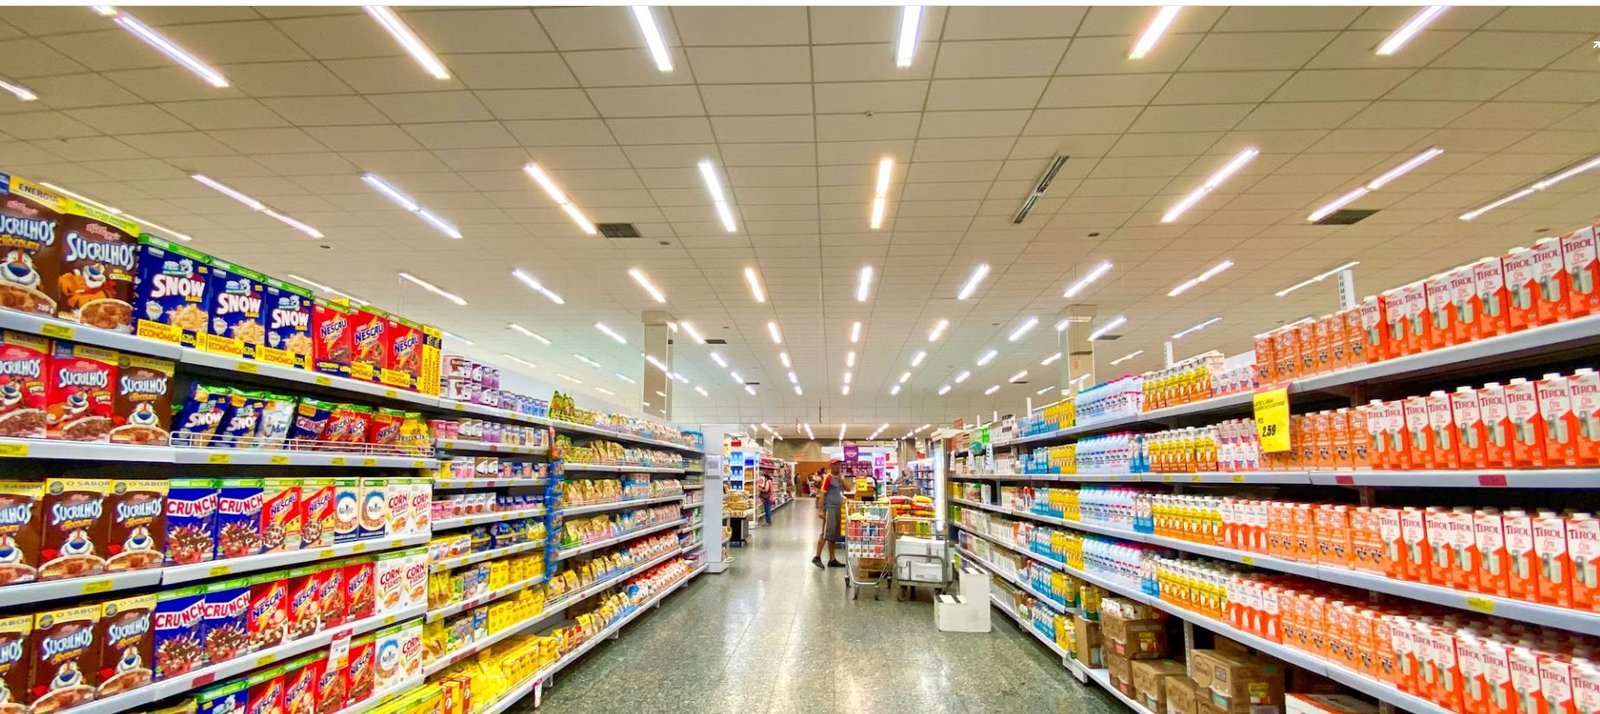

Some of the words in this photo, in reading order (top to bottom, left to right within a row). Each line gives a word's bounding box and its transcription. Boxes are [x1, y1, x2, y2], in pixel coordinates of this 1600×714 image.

[66, 232, 136, 270] SUCRILHOS
[1563, 239, 1594, 253] TIROL
[1505, 259, 1532, 272] TIROL
[1532, 249, 1561, 263] TIROL
[1476, 268, 1500, 280] TIROL
[151, 273, 206, 298] SNOW
[217, 292, 261, 315] SNOW
[271, 308, 309, 329] SNOW
[320, 318, 348, 337] NESCAU
[354, 321, 384, 344] NESCAU
[394, 335, 419, 354] NESCAU
[58, 368, 109, 389] SUCRILHOS
[121, 375, 168, 395] SUCRILHOS
[1506, 393, 1535, 403] TIROL
[1539, 389, 1568, 399] TIROL
[1570, 384, 1600, 396] TIROL
[1454, 400, 1477, 409] TIROL
[1481, 396, 1504, 407] TIROL
[167, 496, 217, 515] CRUNCH
[220, 494, 263, 513] CRUNCH
[271, 492, 297, 516] NESCAU
[308, 490, 332, 512] NESCAU
[388, 493, 408, 509] CORN
[412, 493, 429, 507] CORN
[52, 499, 103, 526] SUCRILHOS
[117, 497, 162, 523] SUCRILHOS
[1475, 524, 1500, 534] TIROL
[1505, 525, 1531, 536] TIROL
[1534, 527, 1565, 539] TIROL
[1568, 529, 1599, 541] TIROL
[380, 568, 401, 585] CORN
[406, 562, 424, 578] CORN
[348, 568, 371, 593] NESCAU
[205, 593, 250, 617] CRUNCH
[252, 586, 285, 620] NESCAU
[292, 580, 318, 611] NESCAU
[155, 602, 205, 628] CRUNCH
[109, 613, 150, 646] SUCRILHOS
[42, 626, 93, 661] SUCRILHOS
[402, 635, 420, 654] CORN
[1482, 654, 1505, 667] TIROL
[1510, 661, 1536, 676] TIROL
[1541, 669, 1568, 685] TIROL
